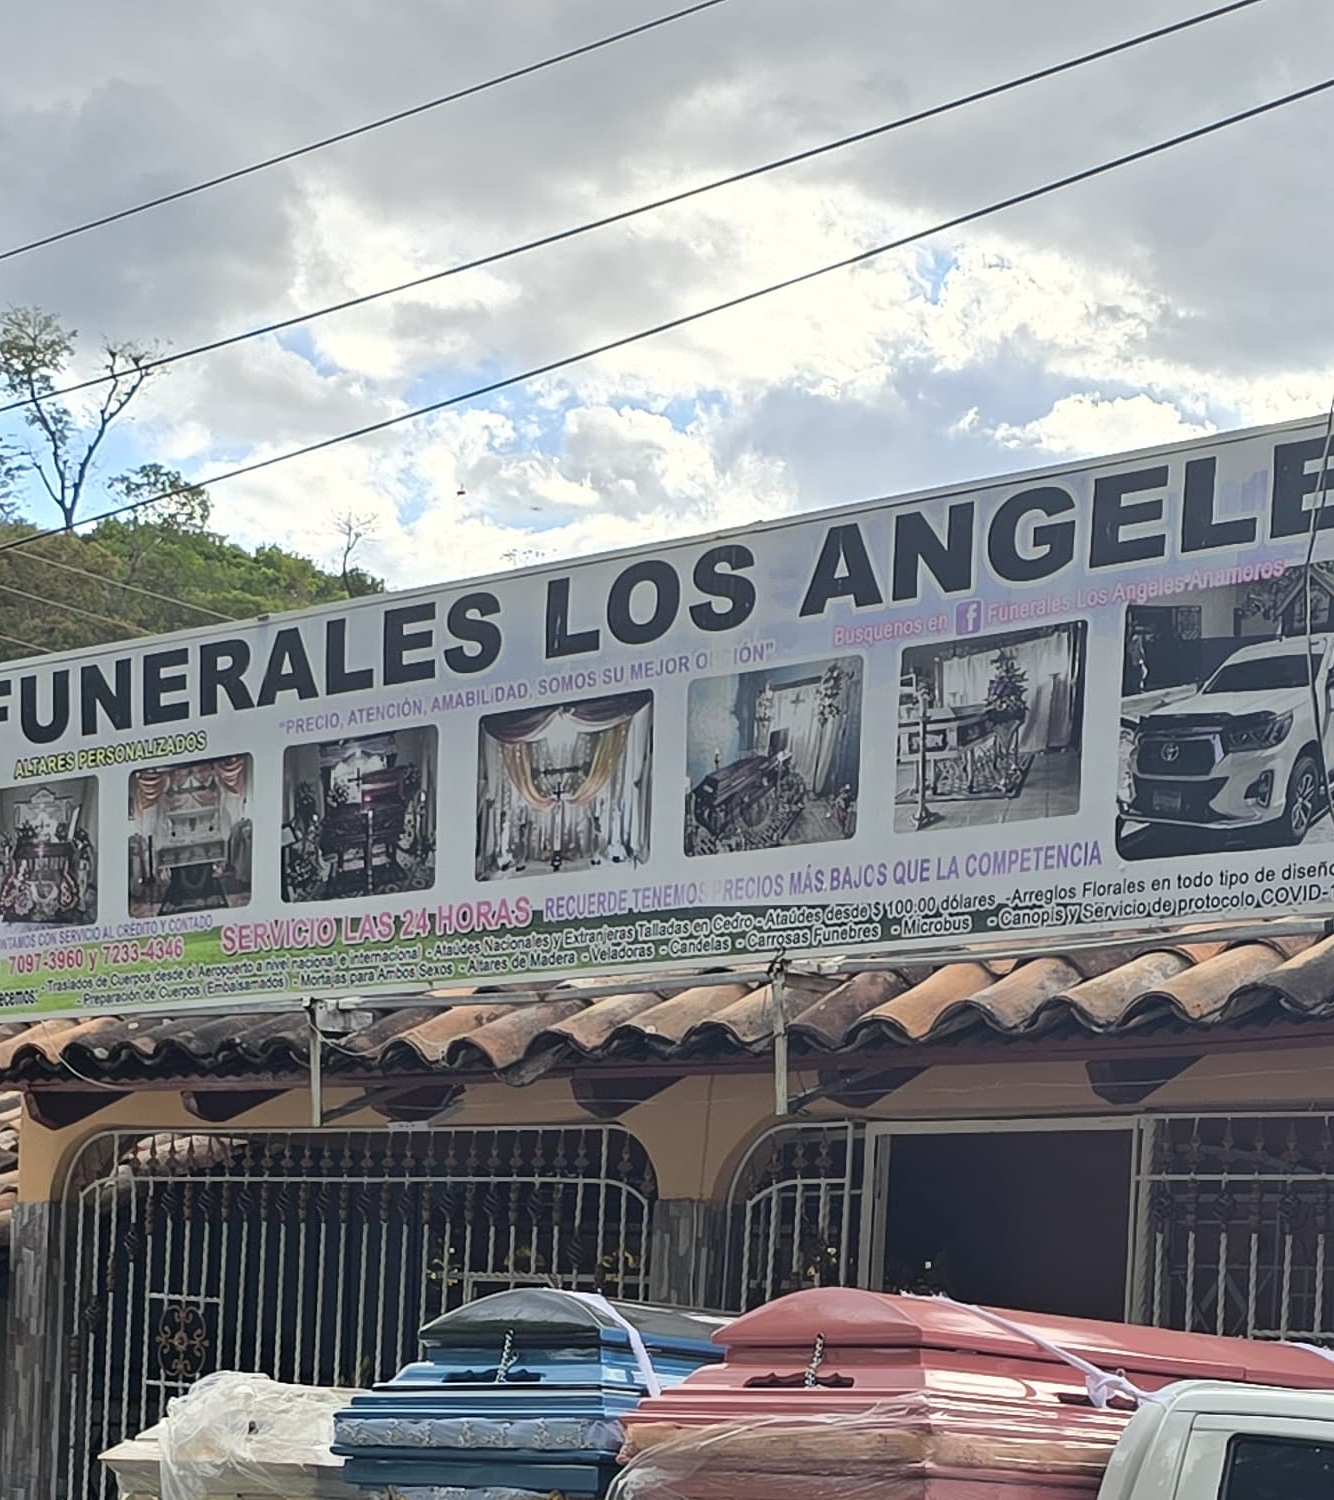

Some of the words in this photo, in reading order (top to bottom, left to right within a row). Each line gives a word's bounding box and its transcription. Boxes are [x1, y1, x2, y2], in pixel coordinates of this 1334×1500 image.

[546, 545, 756, 659] LOS
[834, 617, 922, 648] Busquenos
[927, 615, 948, 634] en
[986, 596, 1069, 624] Funerales
[1077, 588, 1109, 610] Los
[347, 697, 428, 727] ATENCIÓN,
[538, 672, 597, 696] SOMOS
[602, 666, 624, 685] SU
[630, 654, 691, 681] MEJOR
[14, 754, 75, 779] ALTARES
[78, 730, 207, 770] PERSONALIZADOS
[544, 888, 628, 921] RECUERDE
[789, 864, 824, 895] MÁS
[893, 858, 931, 885] QUE
[936, 855, 959, 881] LA
[965, 840, 1102, 879] COMPETENCIA
[766, 906, 820, 929] Ataúdes
[826, 900, 868, 922] desde
[871, 900, 882, 916] $
[941, 892, 996, 912] dólares
[1082, 876, 1146, 898] Florales
[1152, 878, 1171, 891] en
[1177, 870, 1214, 889] todo
[1219, 867, 1250, 890] tipo
[1254, 866, 1275, 884] de
[38, 932, 56, 947] CON
[59, 926, 100, 945] SERVICIO
[102, 926, 115, 939] AL
[159, 921, 166, 932] Y
[168, 914, 214, 932] CONTADO
[220, 916, 336, 955] SERVICIO
[342, 911, 394, 944] LAS
[400, 907, 429, 937] 24
[436, 896, 532, 934] HORAS
[433, 937, 481, 958] Ataúdes
[483, 935, 550, 956] Nacionales
[552, 935, 560, 950] y
[564, 926, 634, 950] Extranjeras
[637, 920, 689, 940] Talladas
[692, 920, 709, 934] en
[713, 914, 753, 934] Cedro
[468, 956, 508, 974] Altares
[511, 953, 527, 969] de
[529, 949, 575, 968] Madera
[669, 936, 730, 957] Candelas
[746, 930, 809, 949] Carrosas
[813, 923, 880, 946] Funebres
[902, 915, 971, 936] Microbus
[1068, 907, 1078, 924] y
[1082, 900, 1147, 920] Servicio
[1152, 897, 1172, 913] de
[1177, 889, 1255, 914] protocolo
[8, 948, 84, 975] 7097-3960
[89, 951, 97, 971] y
[103, 936, 185, 966] 7233-4346
[47, 975, 93, 993] Traslados
[95, 973, 109, 989] de
[110, 970, 151, 988] Cuerpos
[154, 966, 185, 982] desde
[186, 965, 196, 979] el
[197, 961, 254, 982] Aeropuerto
[265, 957, 290, 972] nivel
[291, 953, 337, 970] nacional
[349, 946, 419, 966] internacional
[83, 989, 142, 1008] Preparación
[144, 988, 157, 1002] de
[158, 985, 200, 1002] Cuerpos
[300, 968, 347, 989] Mortajas
[349, 968, 375, 985] para
[376, 962, 416, 981] Ambos
[418, 963, 454, 979] Sexos
